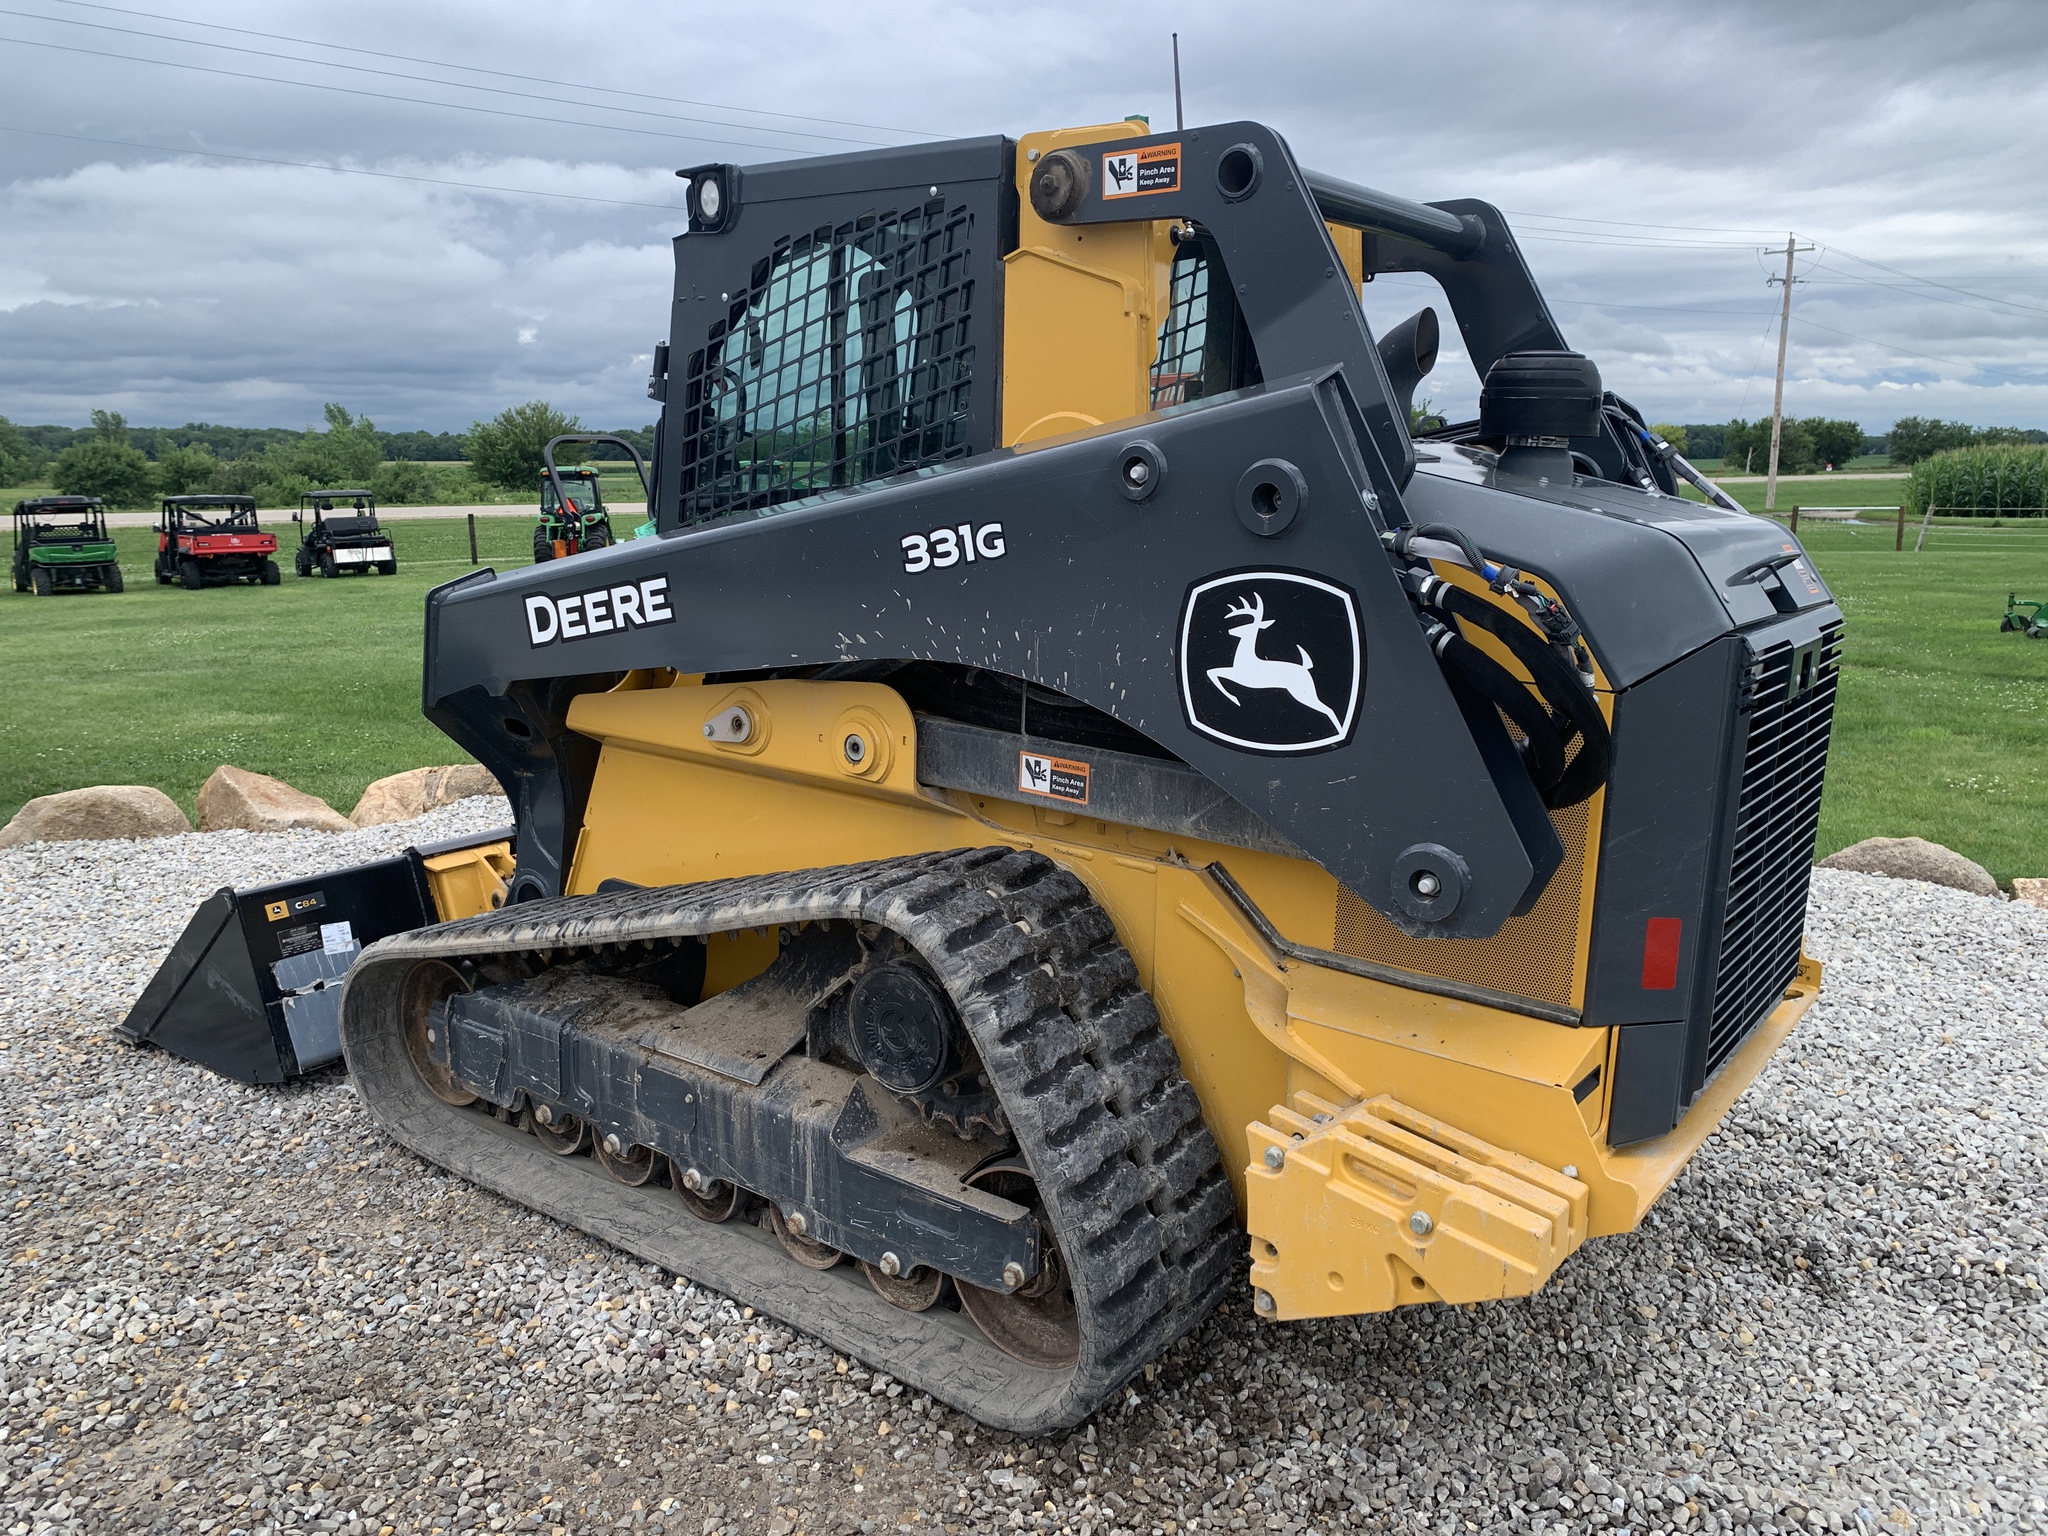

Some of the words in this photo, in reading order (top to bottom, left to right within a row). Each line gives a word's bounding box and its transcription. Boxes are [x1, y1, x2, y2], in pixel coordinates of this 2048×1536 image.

[1146, 148, 1177, 159] WARNING
[1139, 168, 1158, 177] Pinch
[1159, 166, 1175, 174] Area
[1139, 178, 1154, 186] Keep
[1154, 177, 1170, 185] Away
[901, 523, 1006, 573] 331G
[525, 577, 673, 645] DEERE
[1058, 762, 1086, 773] WARNING
[1052, 775, 1069, 784] Pinch
[1069, 778, 1084, 788] Area
[1051, 784, 1066, 793] Keep
[1065, 786, 1080, 795] Away
[295, 898, 317, 909] C84
